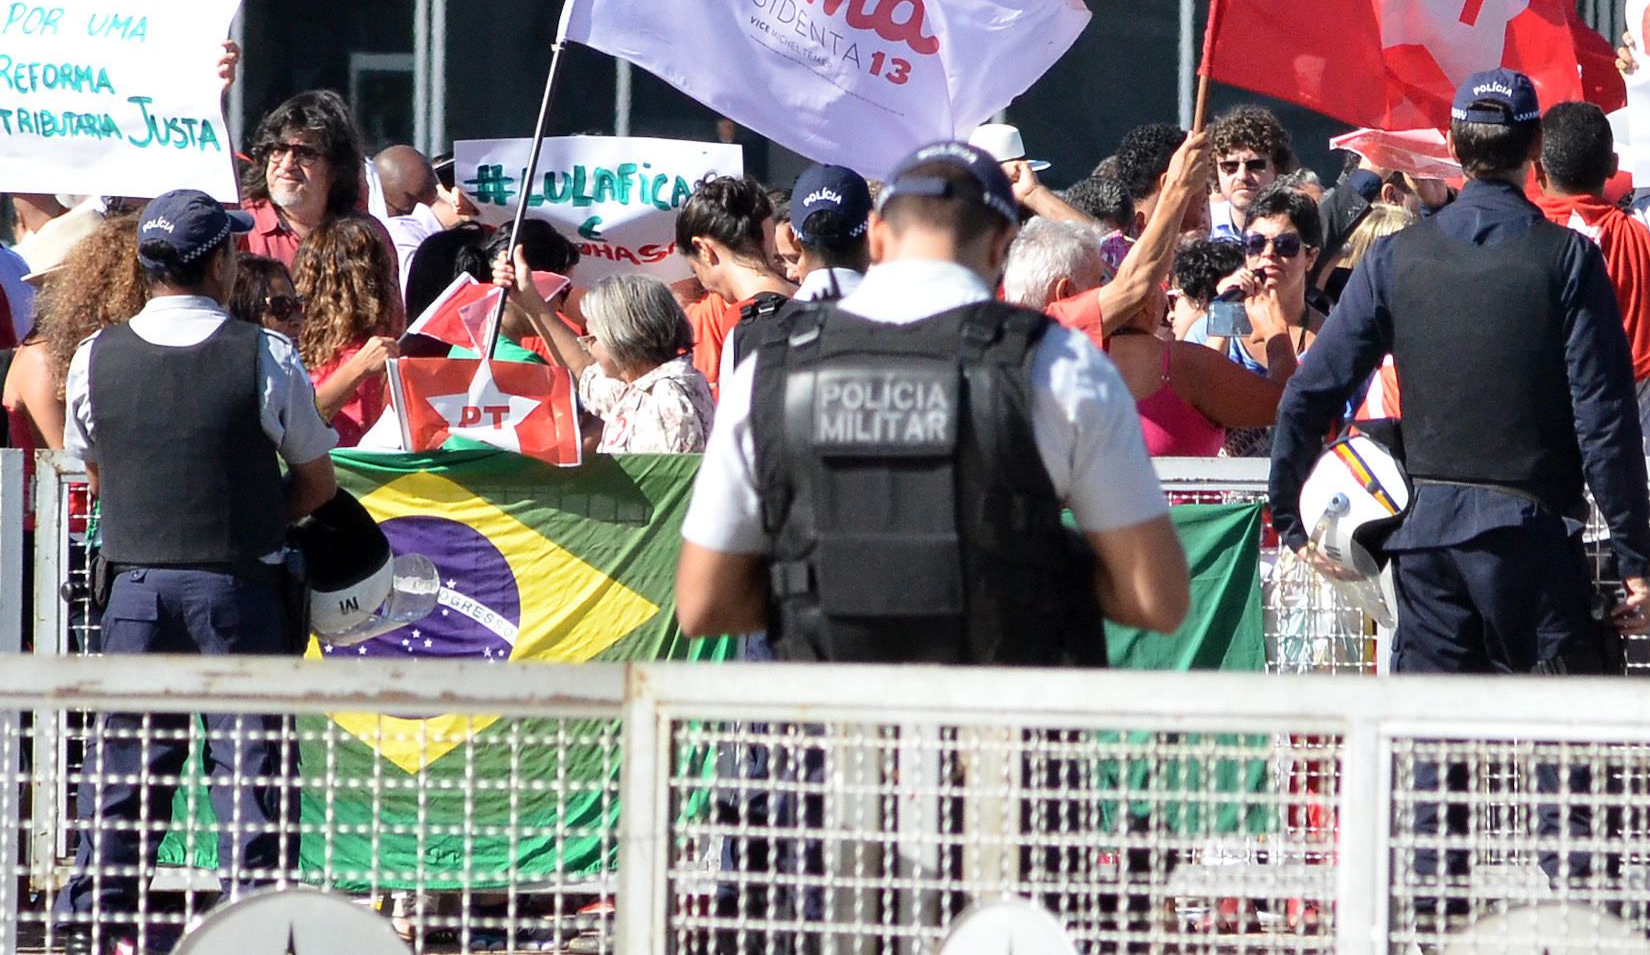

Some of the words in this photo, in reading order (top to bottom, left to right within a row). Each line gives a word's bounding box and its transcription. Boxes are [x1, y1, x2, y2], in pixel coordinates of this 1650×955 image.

[2, 2, 65, 35] POR
[87, 13, 148, 43] UMA
[749, 15, 771, 34] VICE
[0, 54, 116, 95] REFORMA
[868, 50, 912, 85] 13
[1473, 81, 1513, 97] POLÍCIA
[0, 108, 123, 140] TRIBUTARIA
[127, 96, 222, 152] JUSTA
[803, 186, 842, 207] POLÍCIA
[142, 216, 175, 234] POLÍCIA
[821, 372, 948, 410] POLÍCIA
[458, 405, 511, 430] PT
[821, 410, 948, 443] MILITAR
[440, 590, 515, 638] OGRESSO
